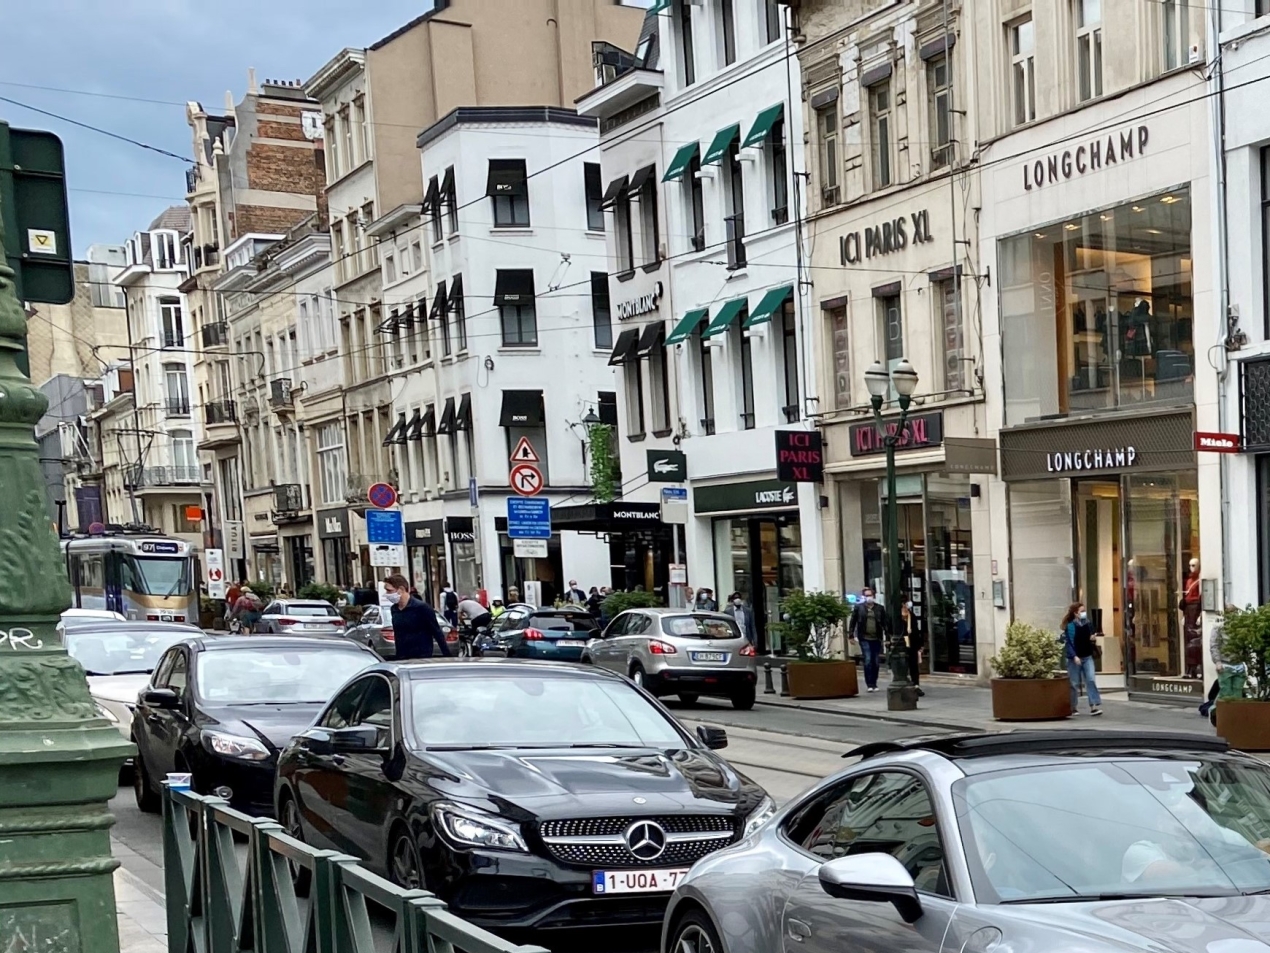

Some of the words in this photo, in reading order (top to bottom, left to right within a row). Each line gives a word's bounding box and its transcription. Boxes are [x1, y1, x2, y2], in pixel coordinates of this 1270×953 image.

[1023, 125, 1149, 191] LONGCHAMP
[839, 231, 862, 266] ICI
[865, 216, 908, 259] PARIS
[911, 209, 934, 245] XL
[617, 296, 660, 321] MONTBLANC
[912, 418, 928, 443] XL
[789, 433, 809, 447] ICI
[1200, 437, 1233, 448] Miele
[780, 450, 820, 463] PARIS
[1047, 446, 1136, 471] LONGCHAMP
[792, 466, 810, 479] XL
[755, 490, 782, 503] LACOSTE
[614, 511, 659, 519] MONTBLANC
[450, 532, 475, 540] BOSS
[1152, 683, 1193, 693] LONGCHAMP
